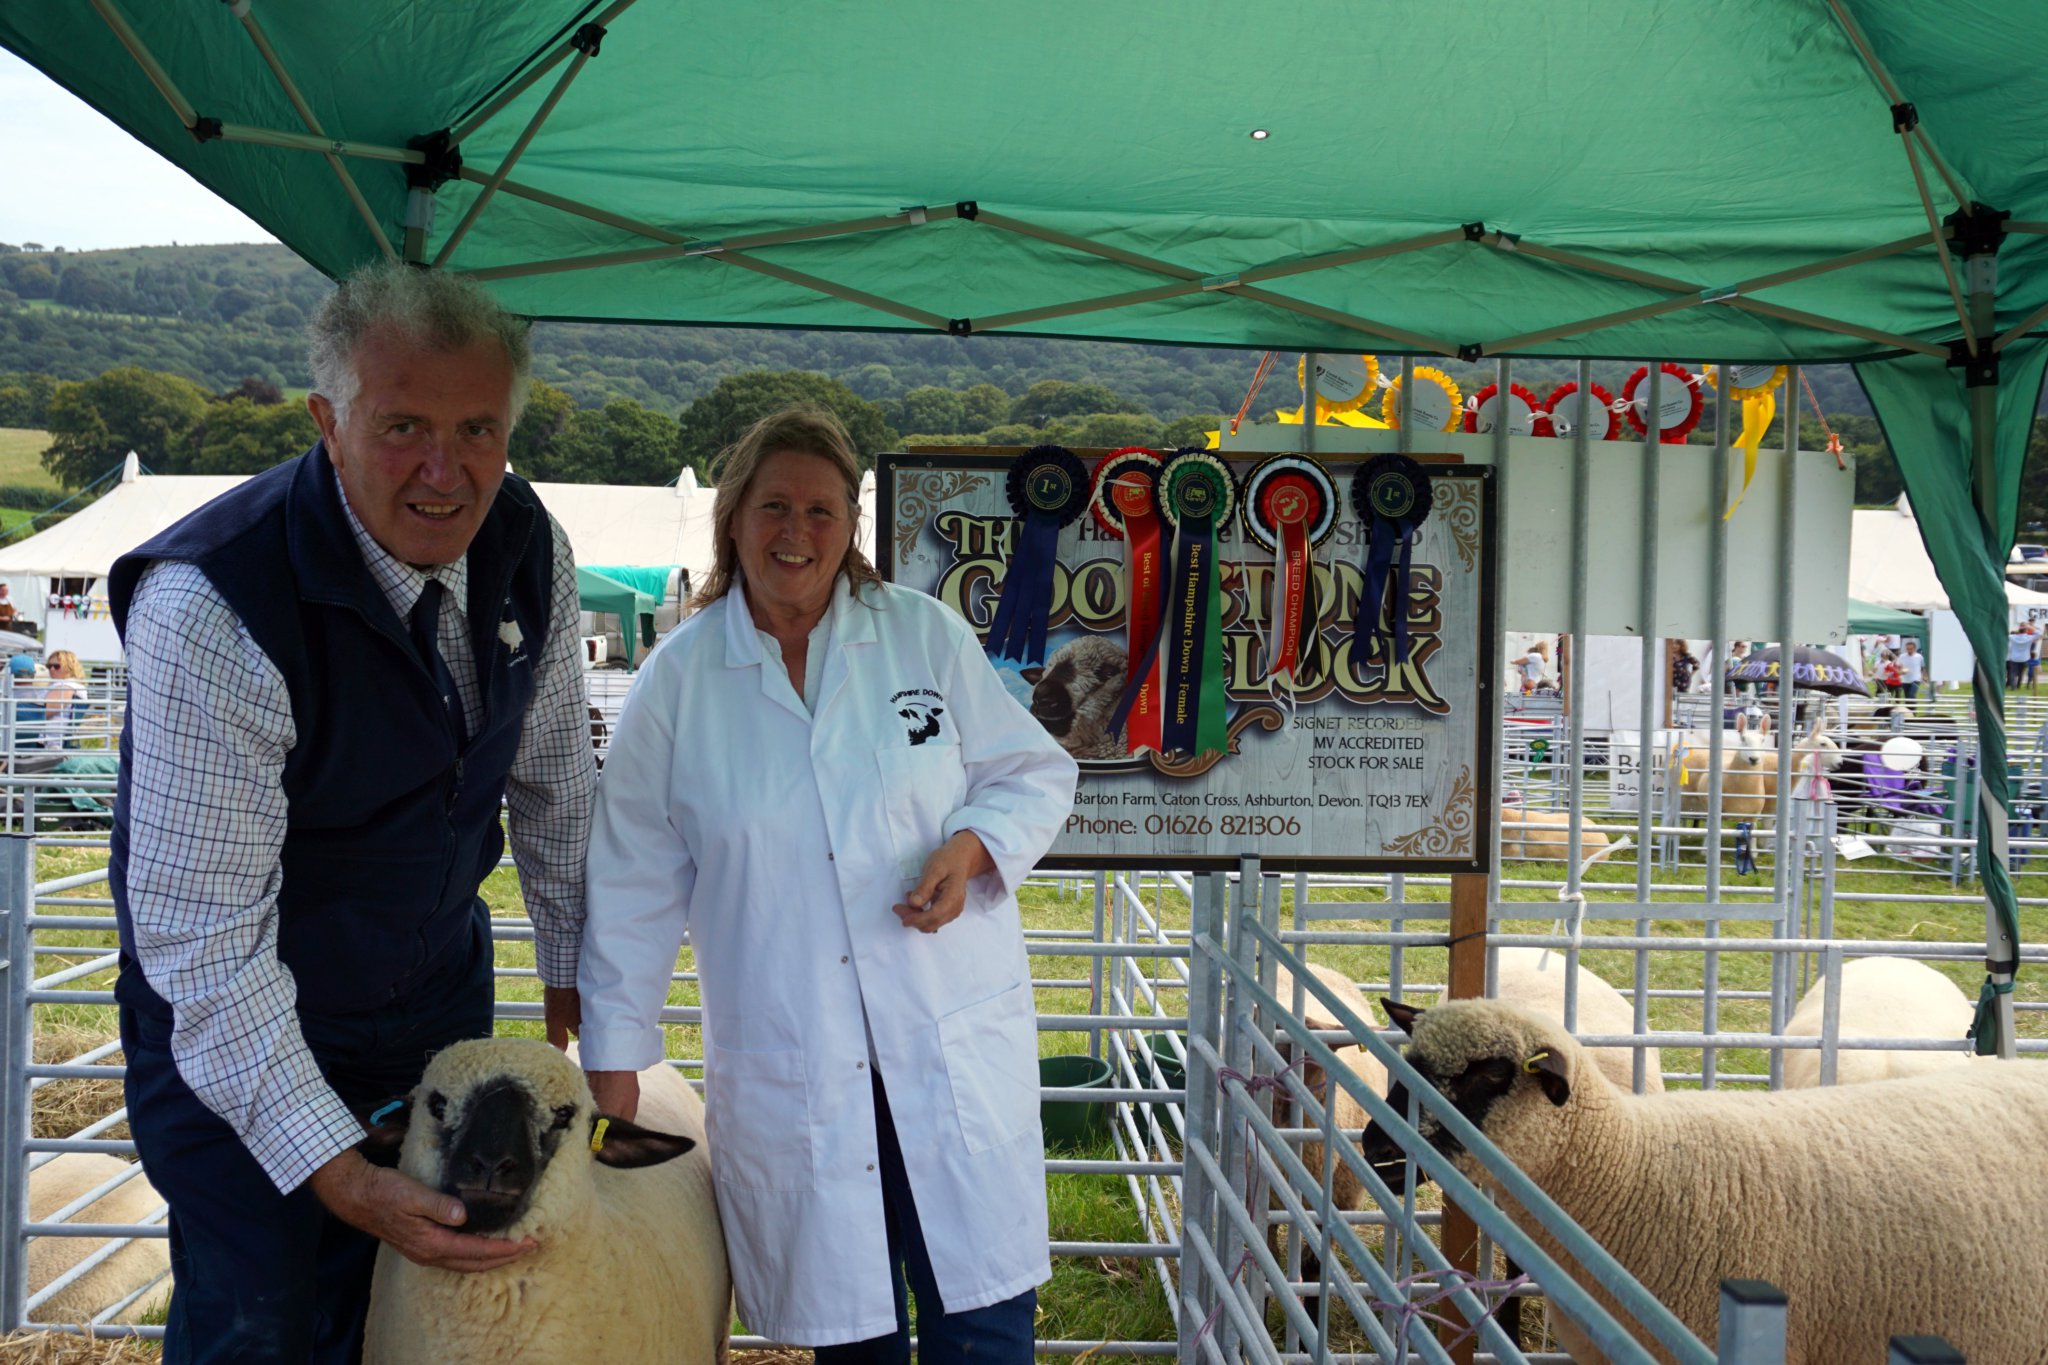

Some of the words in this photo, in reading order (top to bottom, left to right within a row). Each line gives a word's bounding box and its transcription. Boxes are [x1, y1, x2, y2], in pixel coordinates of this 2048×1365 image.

[936, 512, 1026, 557] TH
[1143, 552, 1152, 574] Best
[1190, 543, 1201, 569] Best
[1291, 550, 1301, 591] BREED
[1184, 572, 1200, 636] Hampshire
[1286, 594, 1299, 656] CHAMPION
[1180, 640, 1194, 674] Down
[922, 688, 944, 702] DOWN
[1140, 683, 1150, 714] Down
[1176, 683, 1190, 725] Female
[1293, 716, 1343, 730] SIGNET
[1347, 717, 1424, 730] RECORDED
[1313, 736, 1335, 749] MV
[1338, 736, 1424, 750] ACCREDITED
[1308, 756, 1355, 770] STOCK
[1359, 756, 1389, 770] FOR
[1392, 756, 1424, 770] SALE
[1074, 792, 1118, 806] Barton
[1122, 792, 1157, 806] Farm,
[1162, 792, 1200, 806] Caton
[1204, 793, 1240, 807] Cross,
[1244, 794, 1314, 808] Ashburton,
[1318, 794, 1363, 808] Devon.
[1368, 795, 1401, 809] TQ13
[1405, 795, 1429, 808] 7EX
[1065, 814, 1137, 834] Phone:
[1144, 814, 1213, 835] 01626
[1220, 815, 1301, 836] 821306
